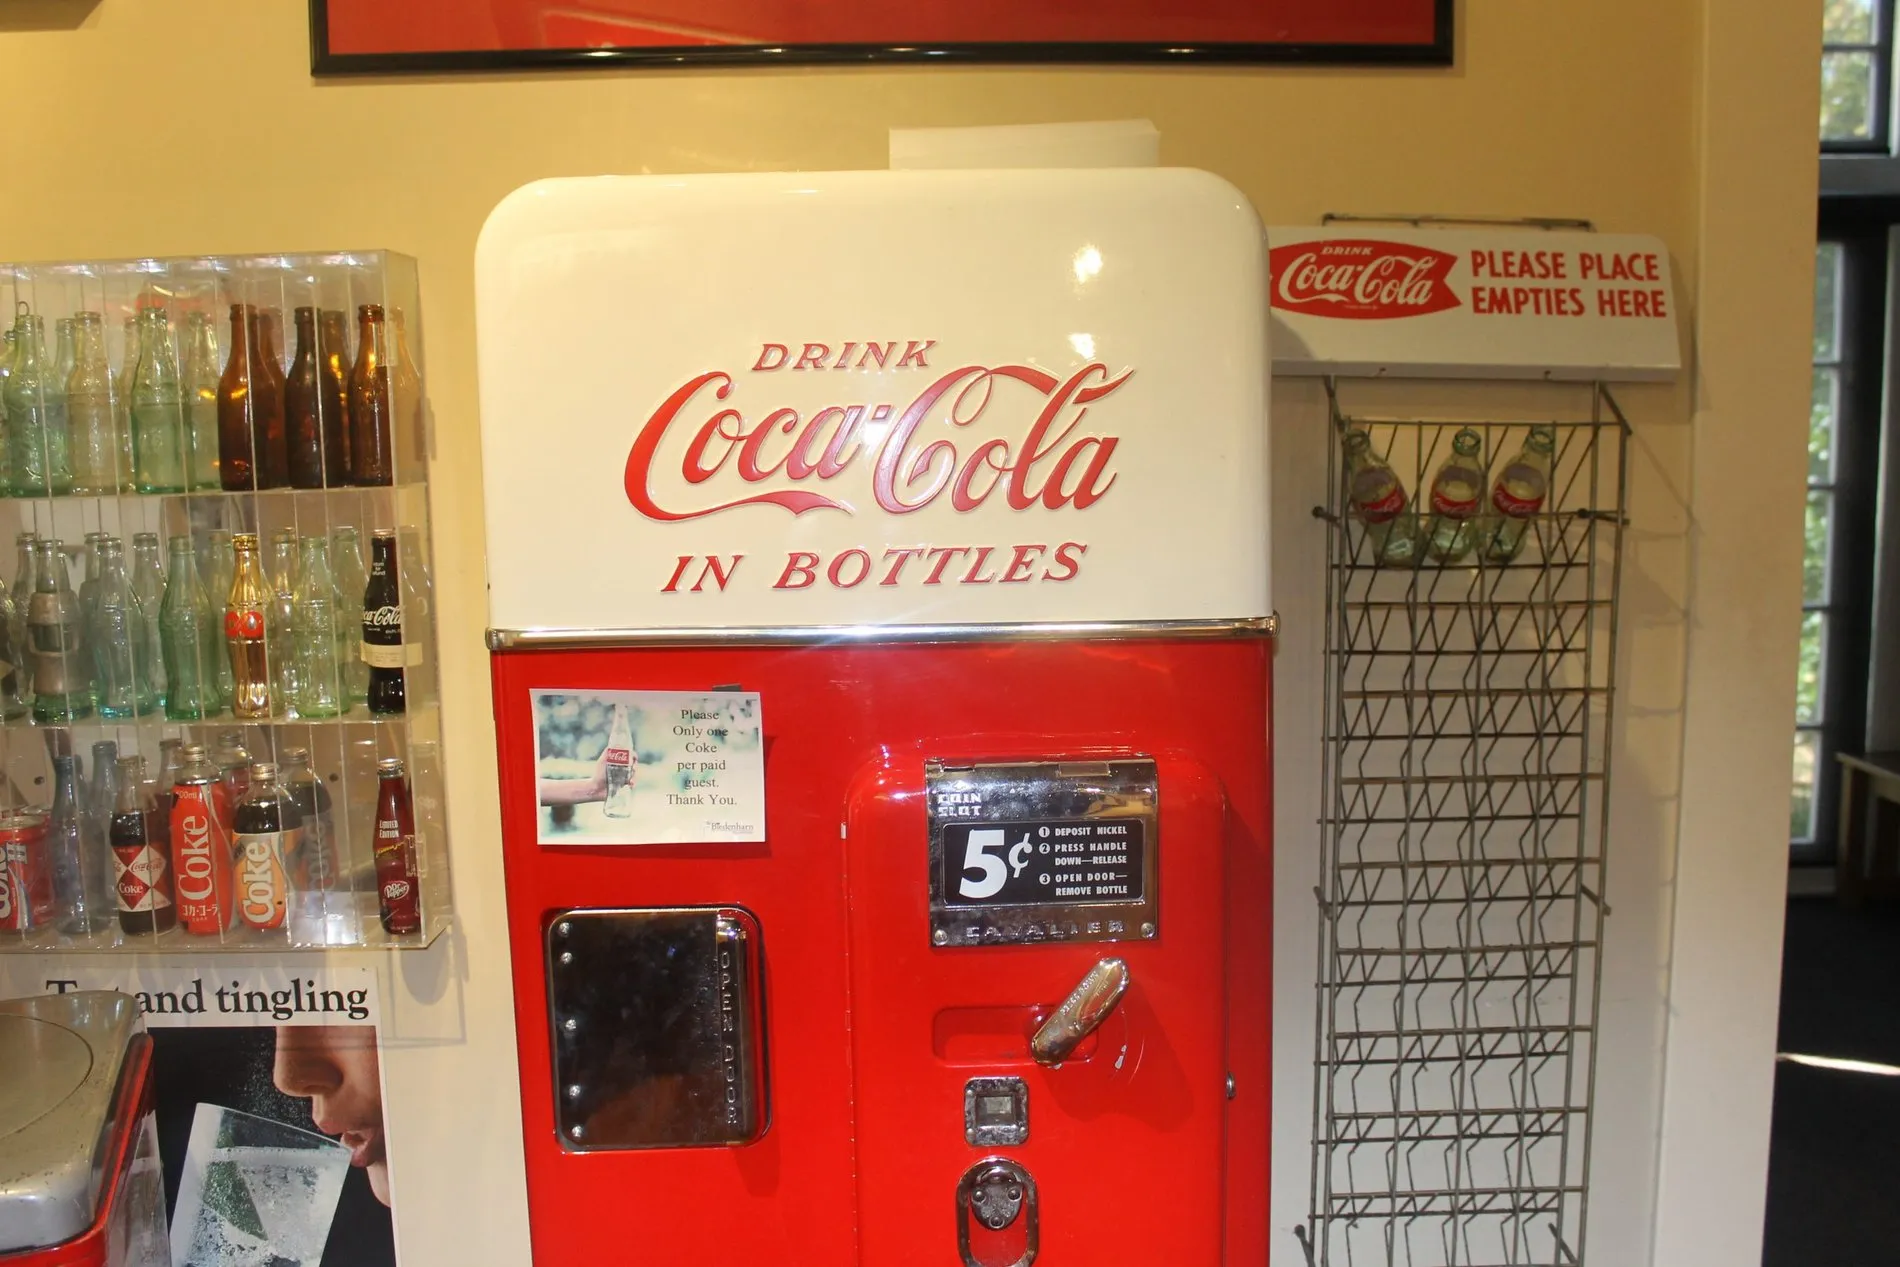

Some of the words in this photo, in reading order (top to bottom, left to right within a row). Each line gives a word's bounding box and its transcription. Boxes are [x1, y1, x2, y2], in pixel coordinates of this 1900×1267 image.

[1321, 246, 1374, 256] DRINK
[1471, 250, 1567, 279] PLEASE
[1579, 252, 1660, 282] PLACE
[1278, 252, 1438, 305] Coca-Cola
[1471, 286, 1586, 317] EMPTIES
[1597, 289, 1667, 318] HERE
[752, 340, 937, 372] DRINK
[624, 362, 1136, 522] Coca-Cola
[660, 555, 744, 593] IN
[772, 541, 1089, 591] BOTTLES
[681, 709, 720, 720] Please
[673, 725, 704, 739] Only
[707, 728, 729, 737] one
[685, 742, 718, 753] Coke
[677, 762, 697, 772] per
[700, 760, 726, 772] paid
[684, 779, 719, 790] guest.
[176, 790, 197, 799] 00ml
[666, 794, 705, 805] Thank
[709, 794, 737, 805] You.
[937, 792, 981, 804] COIN
[938, 805, 981, 817] SLOT
[380, 820, 399, 829] LIMITED
[380, 830, 399, 838] EDITION
[1055, 827, 1091, 837] DEPOSIT
[1097, 826, 1127, 836] NICKEL
[1054, 843, 1084, 853] PRESS
[1090, 842, 1127, 852] HANDLE
[178, 815, 213, 900] Coke
[242, 841, 275, 924] Coke
[1055, 873, 1083, 883] OPEN
[119, 882, 144, 894] Coke
[1055, 886, 1092, 896] REMOVE
[1096, 885, 1128, 895] BOTTLE
[965, 920, 1125, 938] CAVALIER
[720, 952, 733, 1031] OPEN
[135, 979, 206, 1013] and
[215, 979, 370, 1021] tingling
